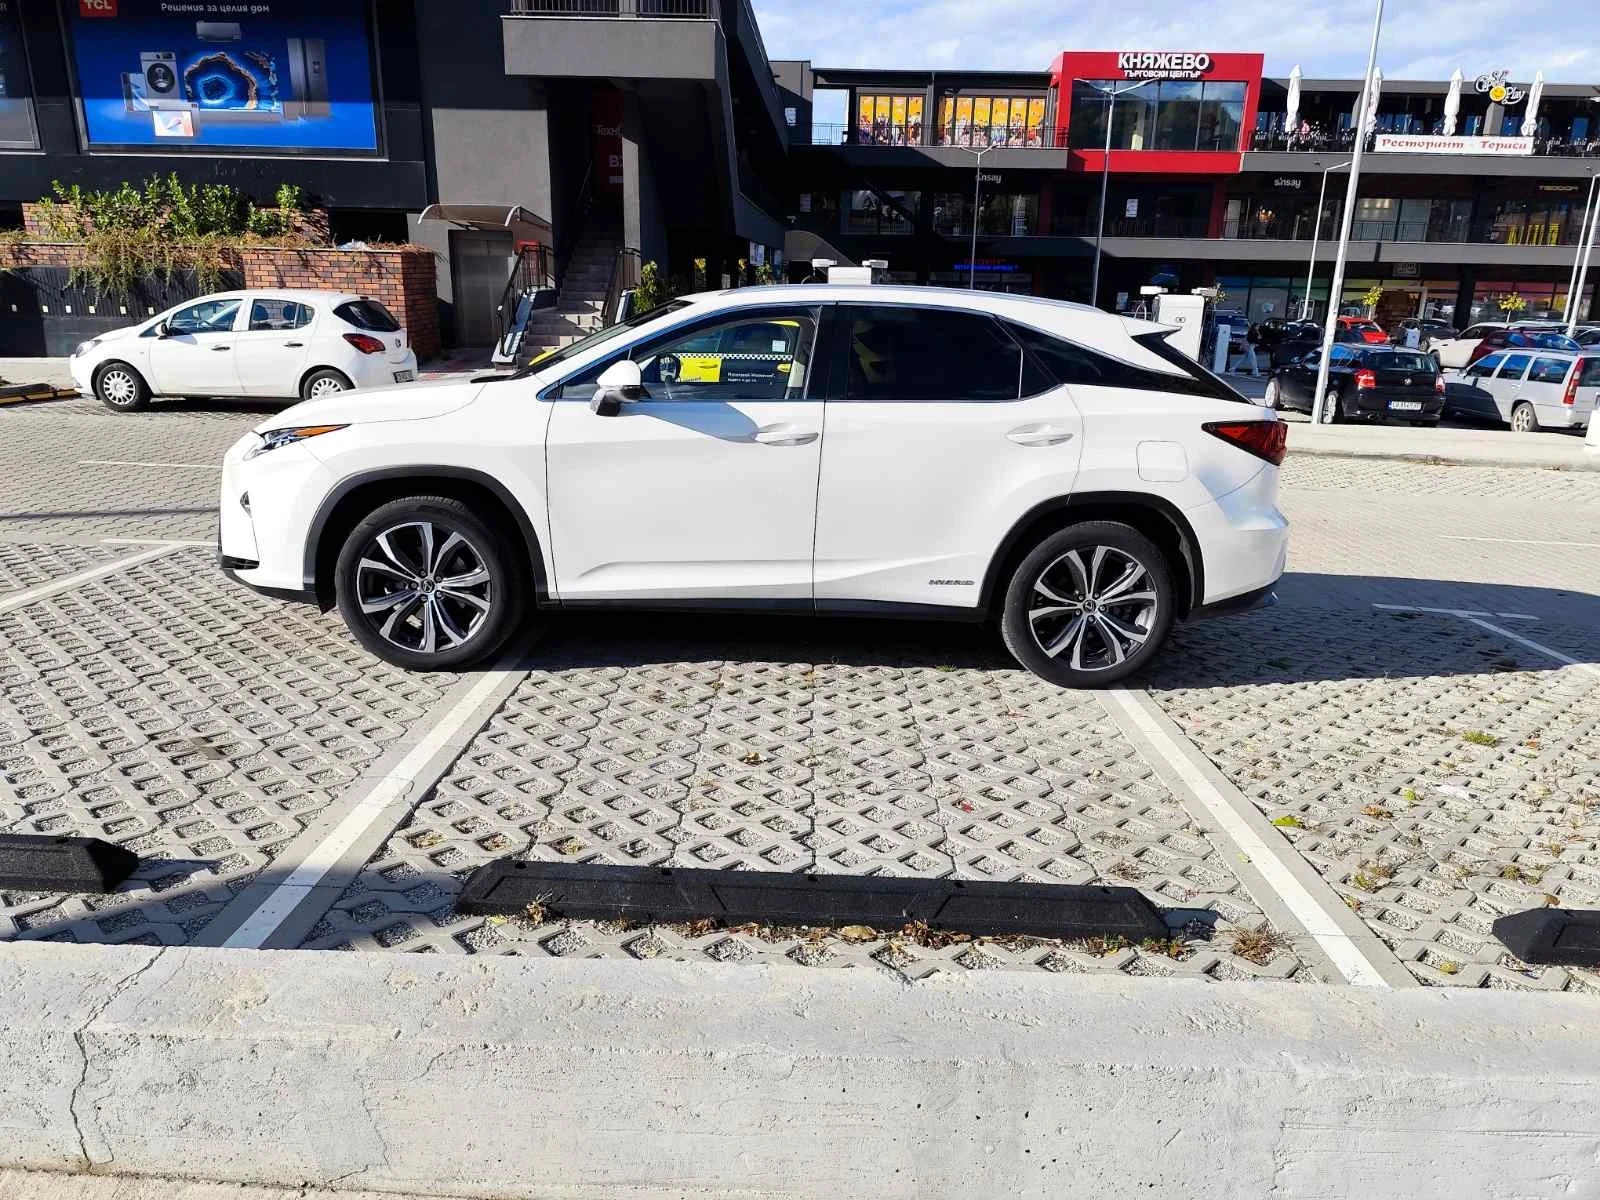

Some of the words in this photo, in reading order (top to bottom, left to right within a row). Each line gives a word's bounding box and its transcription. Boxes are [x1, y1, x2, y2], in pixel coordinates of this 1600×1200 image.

[84, 0, 113, 10] TCL
[1118, 52, 1210, 70] КНЯЖЕВО
[1124, 69, 1168, 78] ТЪРГОВСКИ
[1169, 70, 1201, 79] ЦЕНТЪР
[1382, 138, 1464, 150] Ресторант
